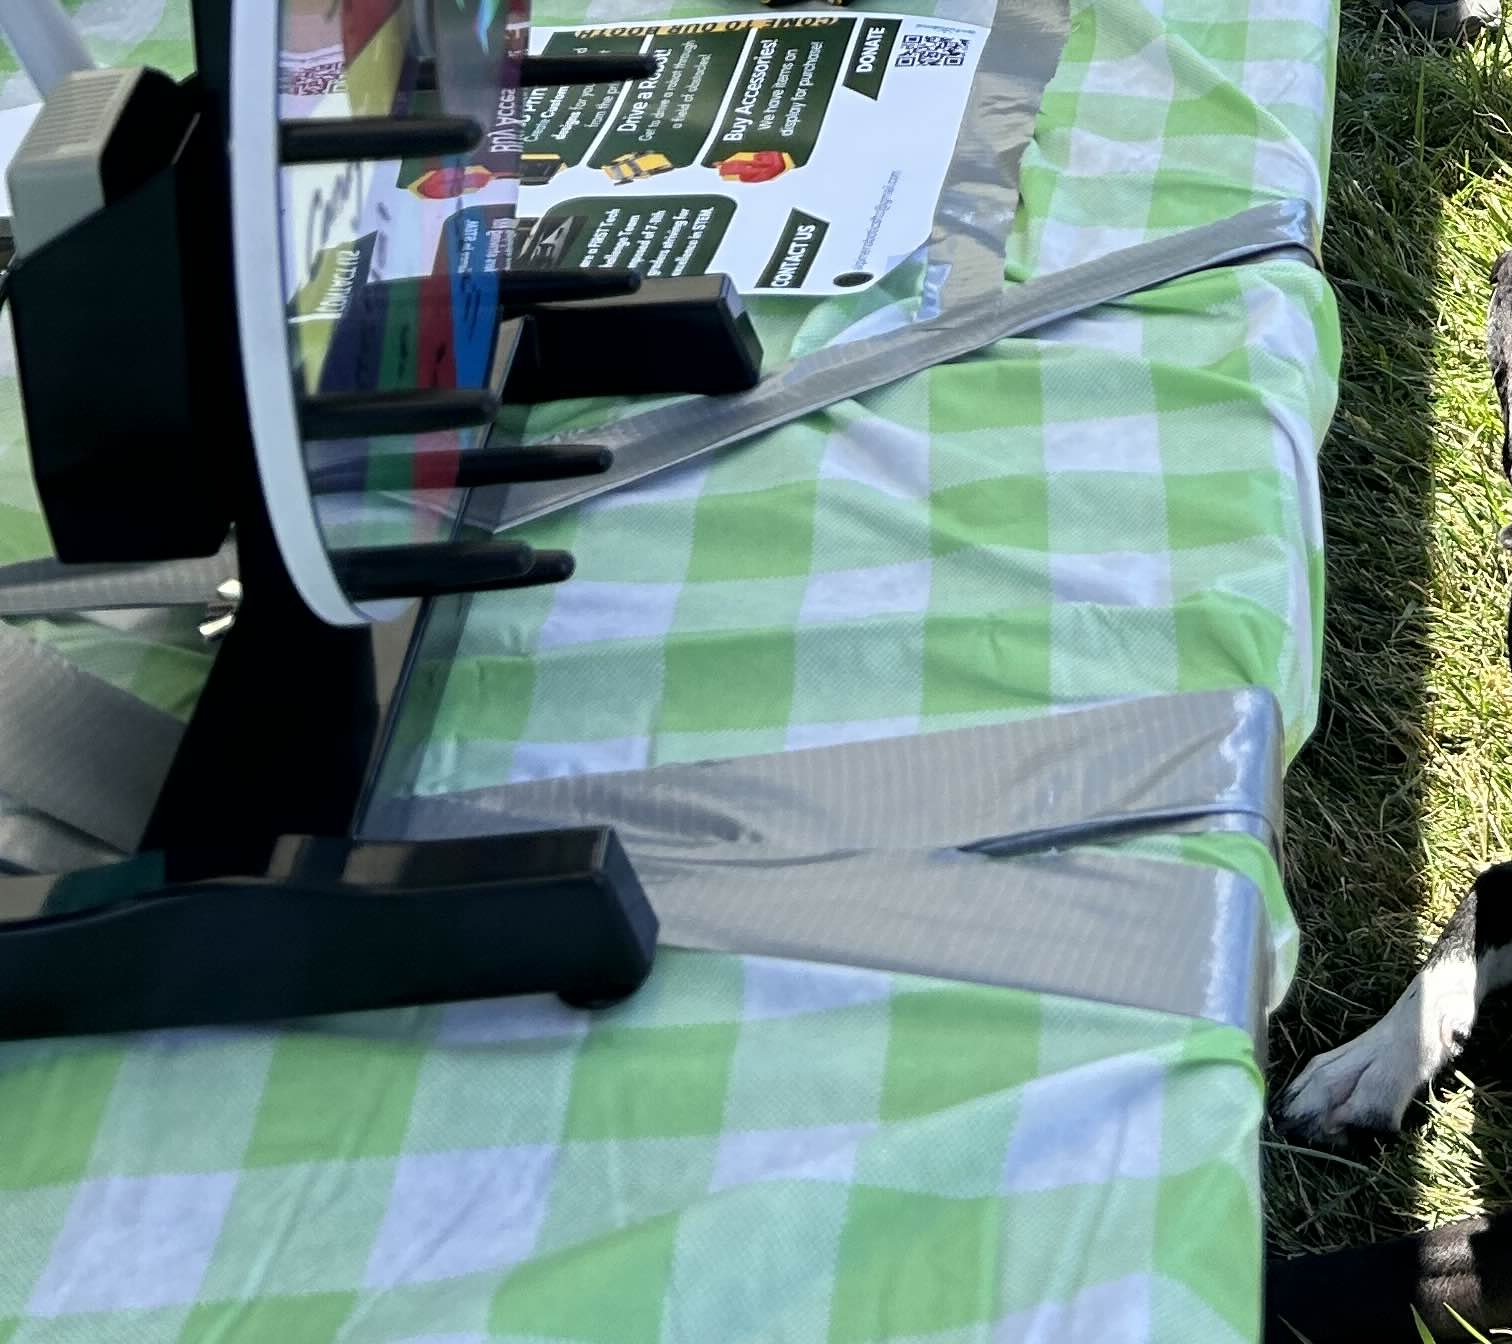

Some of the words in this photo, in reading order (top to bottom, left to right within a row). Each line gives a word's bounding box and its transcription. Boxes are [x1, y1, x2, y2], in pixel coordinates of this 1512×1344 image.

[669, 21, 718, 34] OUR
[785, 48, 799, 63] on
[856, 26, 886, 73] DONATE
[723, 115, 754, 143] Buy
[741, 39, 779, 117] Accessories!
[776, 61, 795, 91] items
[617, 101, 647, 133] Drive
[767, 89, 784, 115] have
[780, 96, 801, 138] display
[794, 84, 807, 101] for
[757, 112, 775, 132] We
[771, 242, 809, 289] CONTACT
[797, 223, 816, 242] US
